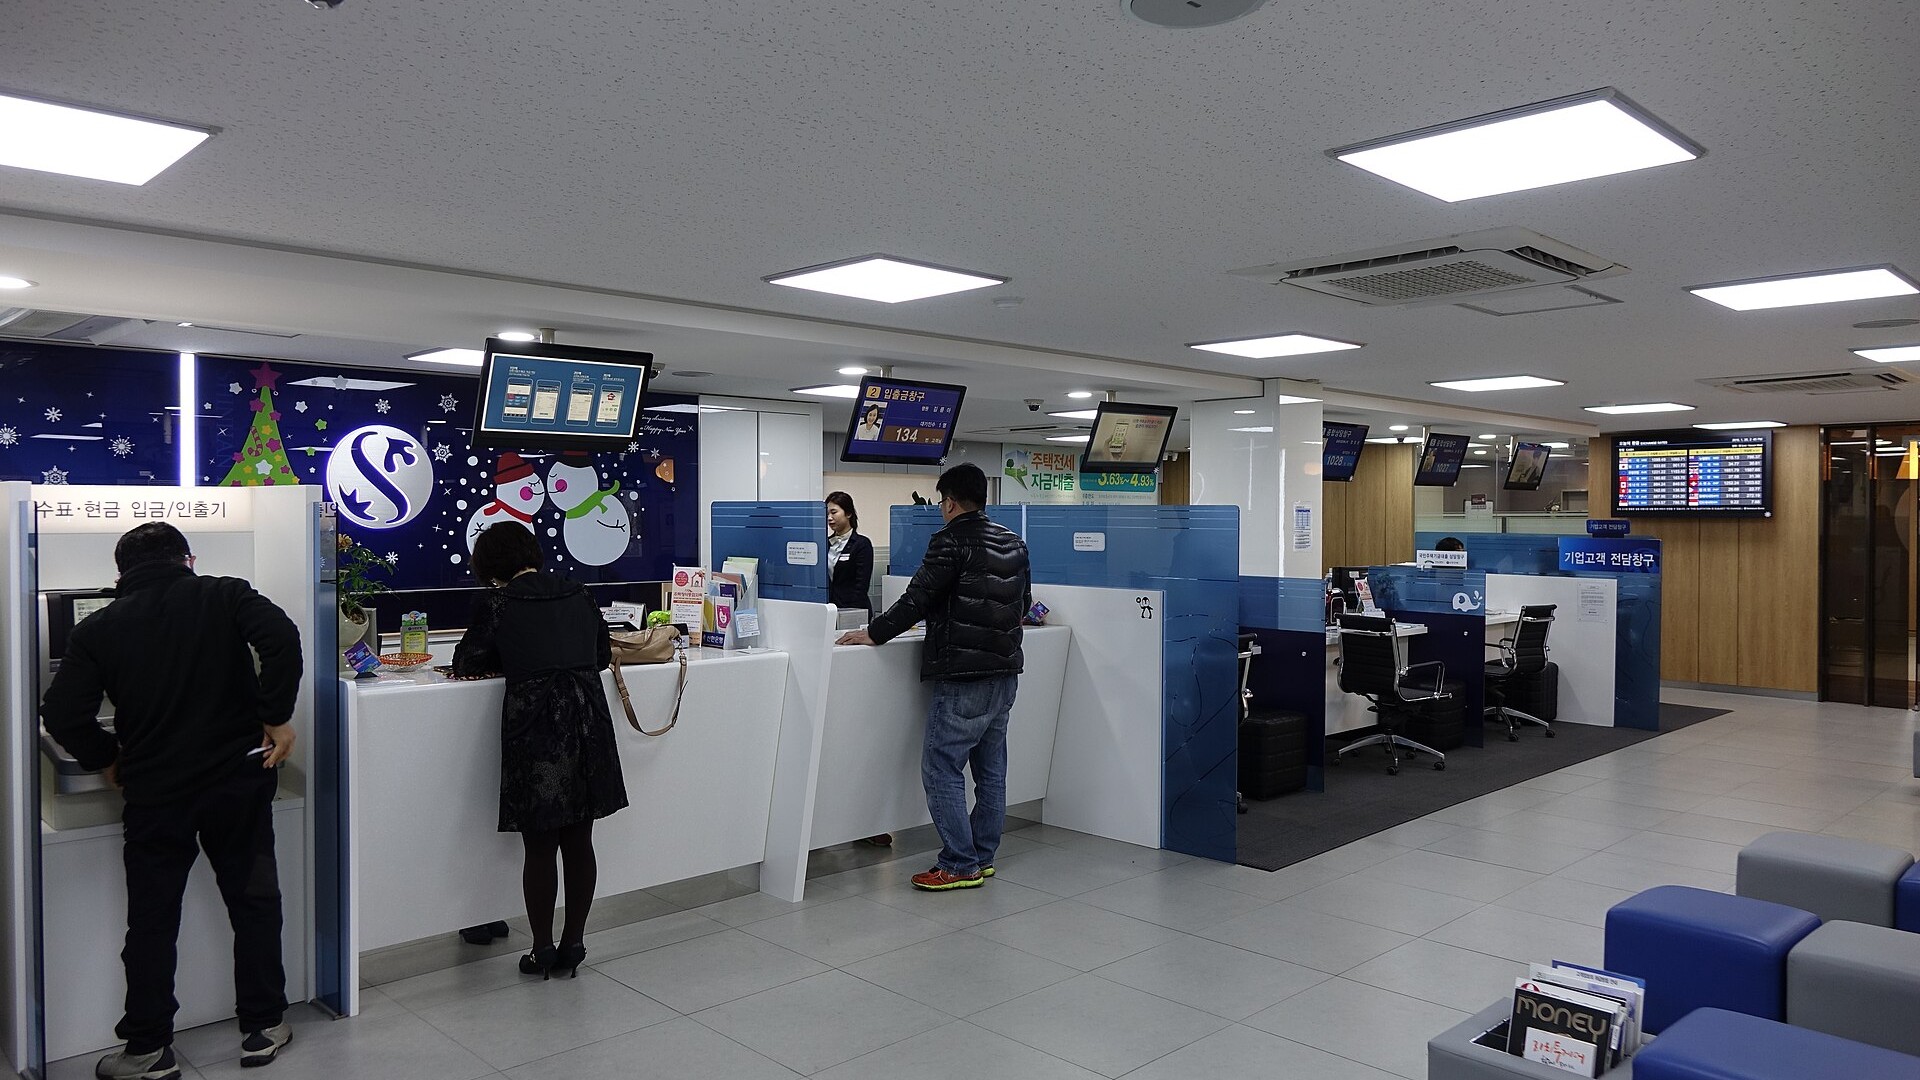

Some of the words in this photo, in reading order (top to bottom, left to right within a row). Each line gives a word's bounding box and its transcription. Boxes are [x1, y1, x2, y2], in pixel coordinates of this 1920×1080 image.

[870, 387, 877, 397] 2
[884, 388, 925, 402] 입출금창구
[641, 414, 651, 424] erry
[896, 427, 918, 443] 134
[1031, 452, 1075, 471] 주택전세
[1326, 455, 1344, 466] 1028
[1435, 462, 1450, 473] 1027
[1031, 473, 1075, 491] 자금대출
[37, 501, 121, 519] 수표·현금
[131, 501, 227, 519] 입금/인출기
[1564, 551, 1606, 565] 기업고객
[1610, 552, 1655, 567] 전담창구
